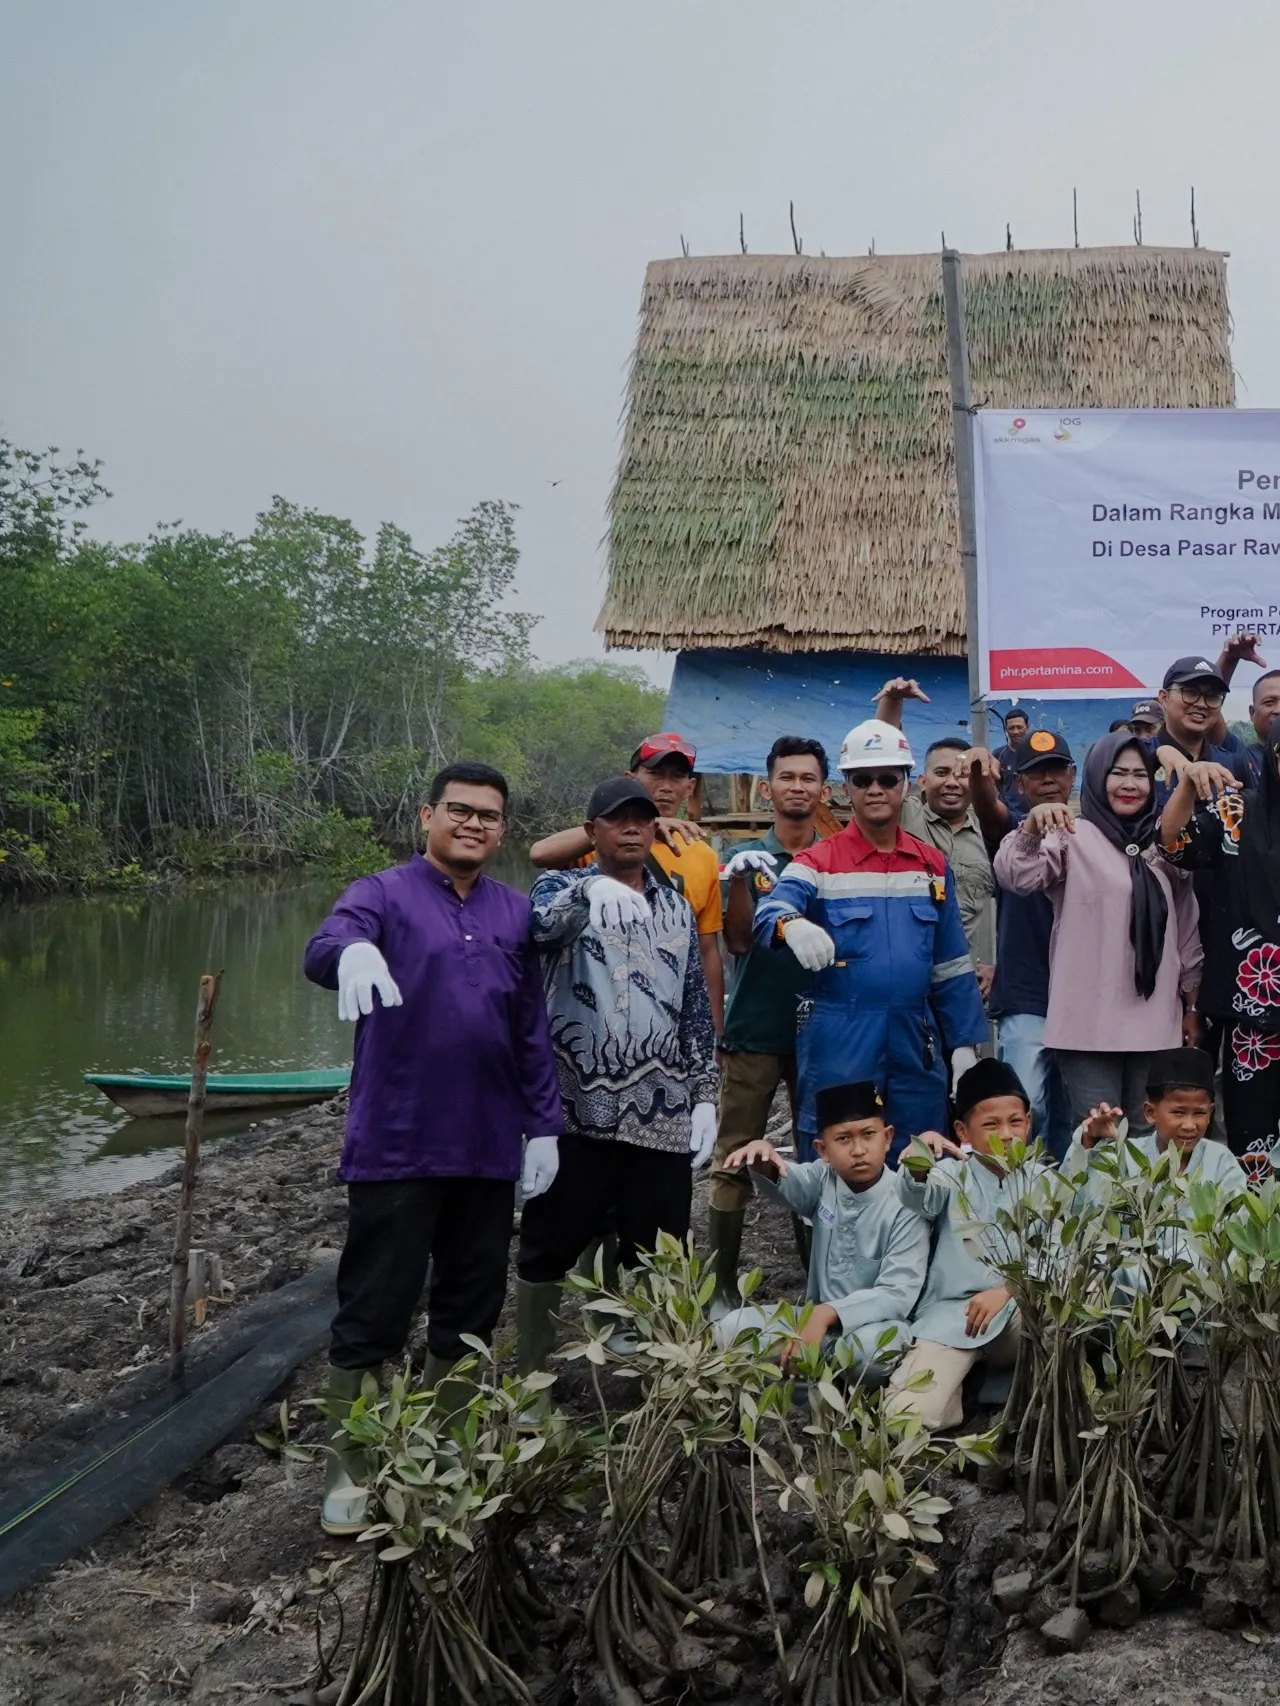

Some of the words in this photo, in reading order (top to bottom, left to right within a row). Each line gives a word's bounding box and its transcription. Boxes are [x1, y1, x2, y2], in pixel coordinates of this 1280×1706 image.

[1092, 503, 1162, 523] Dalam
[1169, 502, 1255, 526] Rangka
[1092, 540, 1113, 558] Di
[1119, 540, 1171, 558] Desa
[1177, 539, 1238, 557] Pasar
[1200, 605, 1264, 622] Program
[1212, 623, 1231, 636] PT
[1000, 664, 1114, 679] phr.pertamina.com
